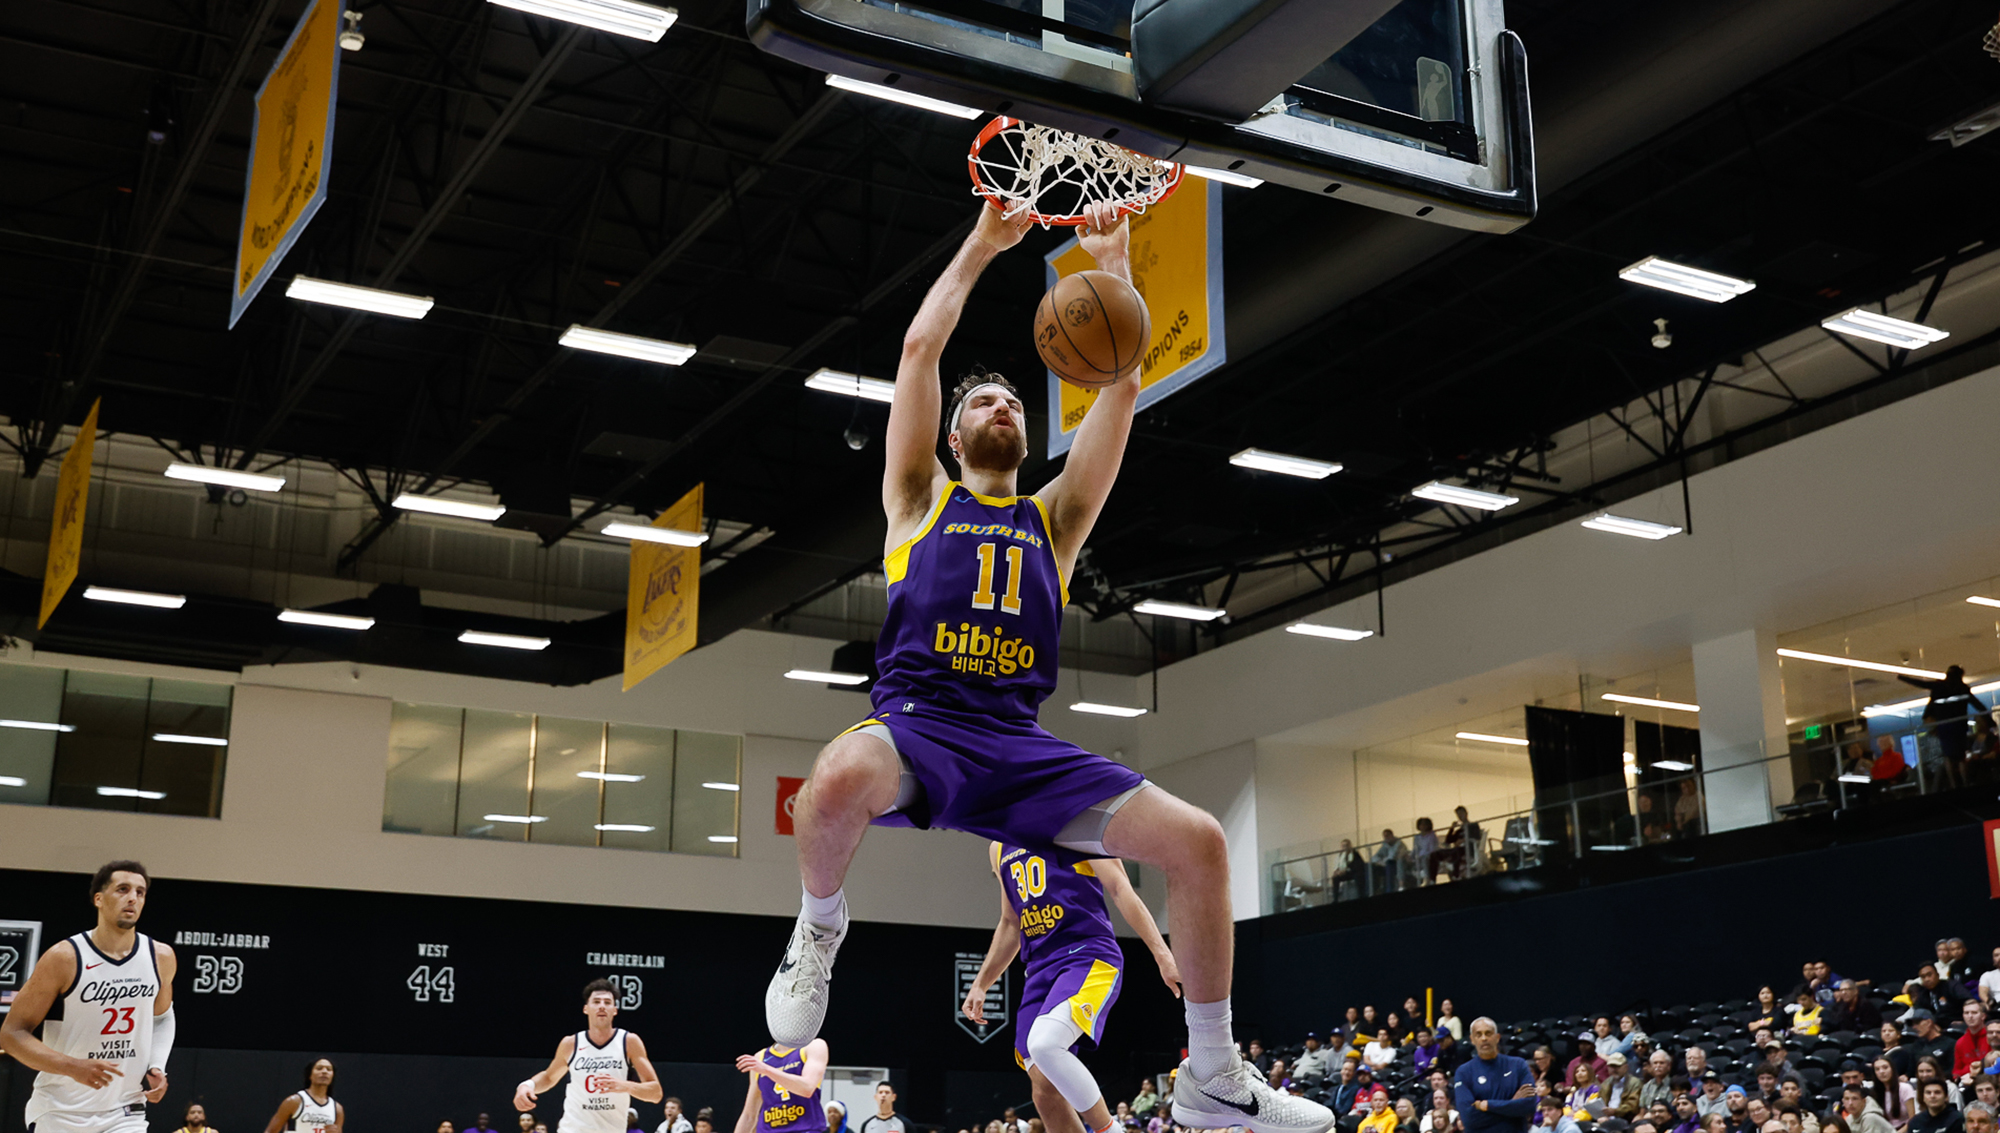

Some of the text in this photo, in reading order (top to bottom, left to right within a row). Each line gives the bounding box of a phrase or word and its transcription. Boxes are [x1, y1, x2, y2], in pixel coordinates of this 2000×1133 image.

[1140, 309, 1190, 378] MPIONS
[1179, 336, 1202, 363] 1954
[1065, 404, 1086, 427] 1953
[943, 522, 1043, 549] SOUTH BAY
[971, 542, 1023, 616] 11
[934, 622, 1035, 675] bibigo
[951, 656, 996, 678] 비비고
[1001, 848, 1027, 866] SOUT
[1010, 856, 1047, 903] 30
[1020, 904, 1064, 930] ibigo
[175, 931, 270, 949] ABDUL-JABBAR
[418, 943, 449, 958] WEST
[586, 952, 665, 969] CHAMBERLAIN
[193, 955, 244, 994] 33
[407, 965, 455, 1003] 44
[80, 980, 155, 1007] Clippers
[100, 1006, 136, 1036] 23
[101, 1040, 131, 1050] VISIT
[574, 1056, 623, 1073] Clippers
[764, 1104, 806, 1123] bibigo
